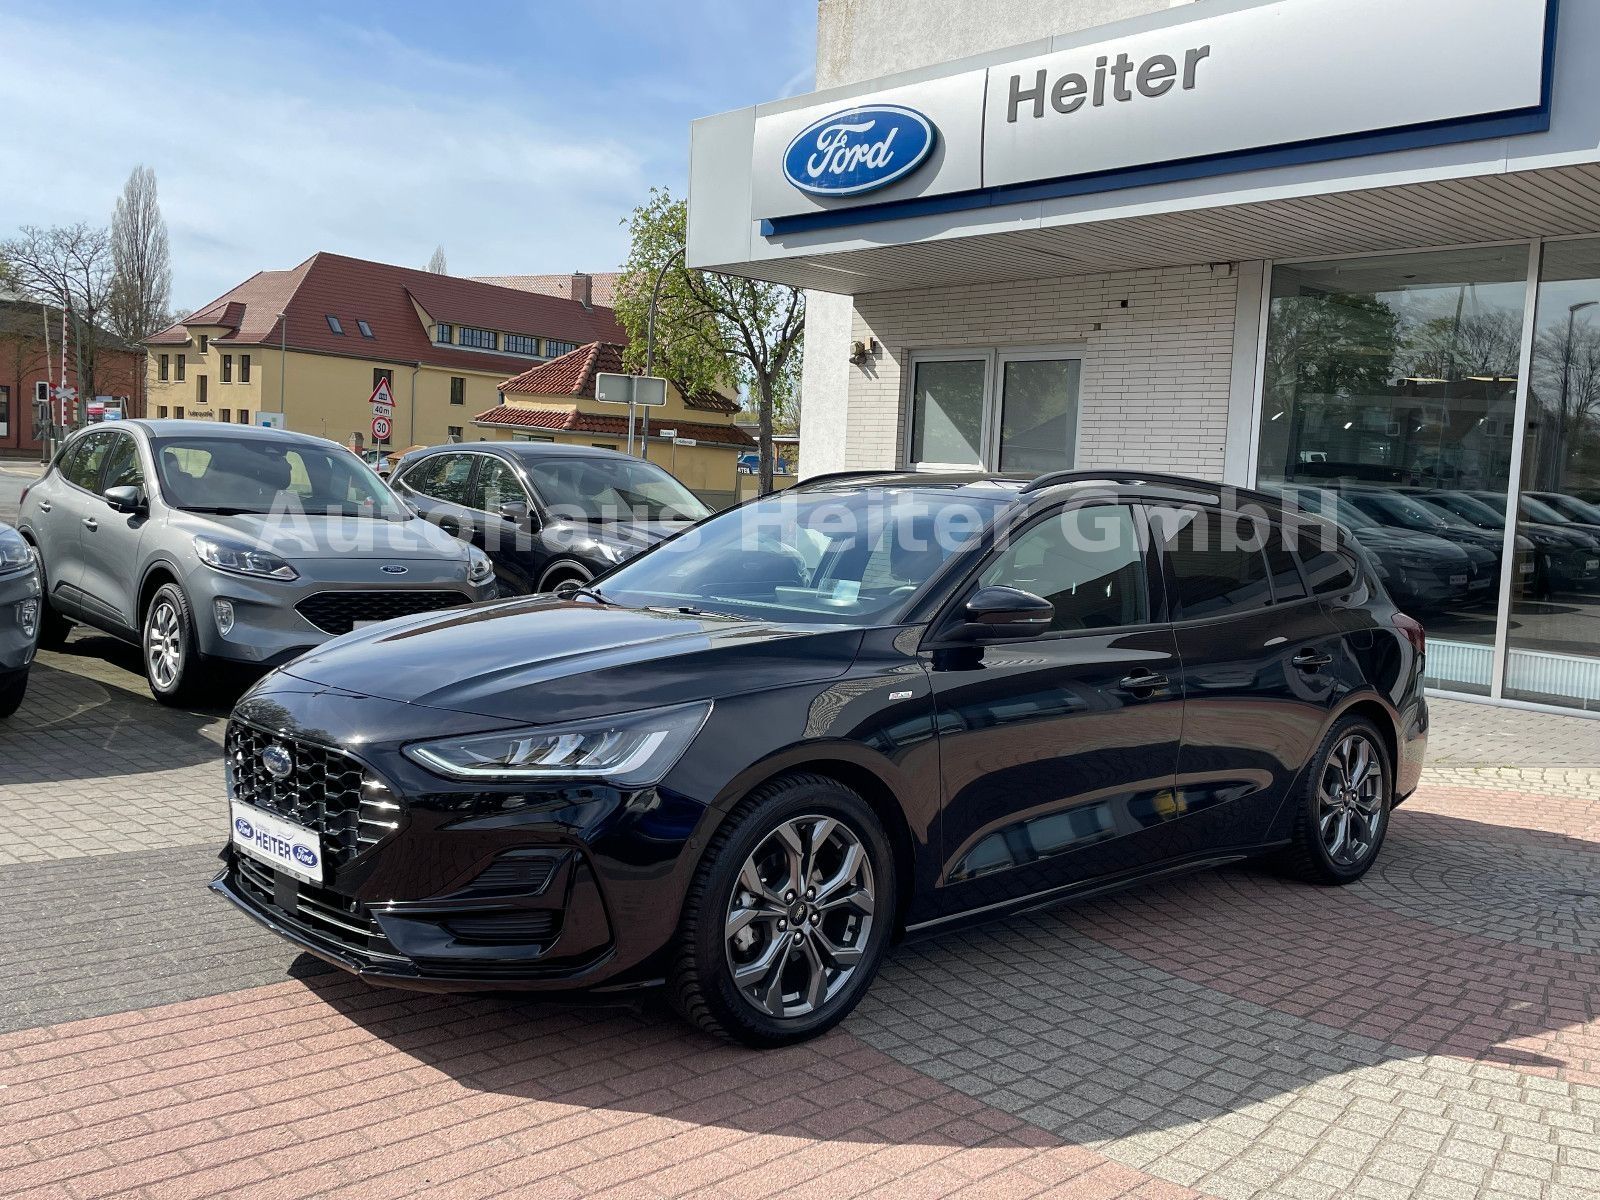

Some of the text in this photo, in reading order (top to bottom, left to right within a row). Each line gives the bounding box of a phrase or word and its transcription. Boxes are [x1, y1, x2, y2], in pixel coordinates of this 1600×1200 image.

[1007, 45, 1210, 123] Heiter
[807, 119, 898, 178] Ford
[374, 405, 383, 414] 40
[376, 422, 387, 434] 30
[237, 819, 252, 839] Ford
[255, 829, 291, 861] HEITER
[295, 846, 315, 865] Ford
